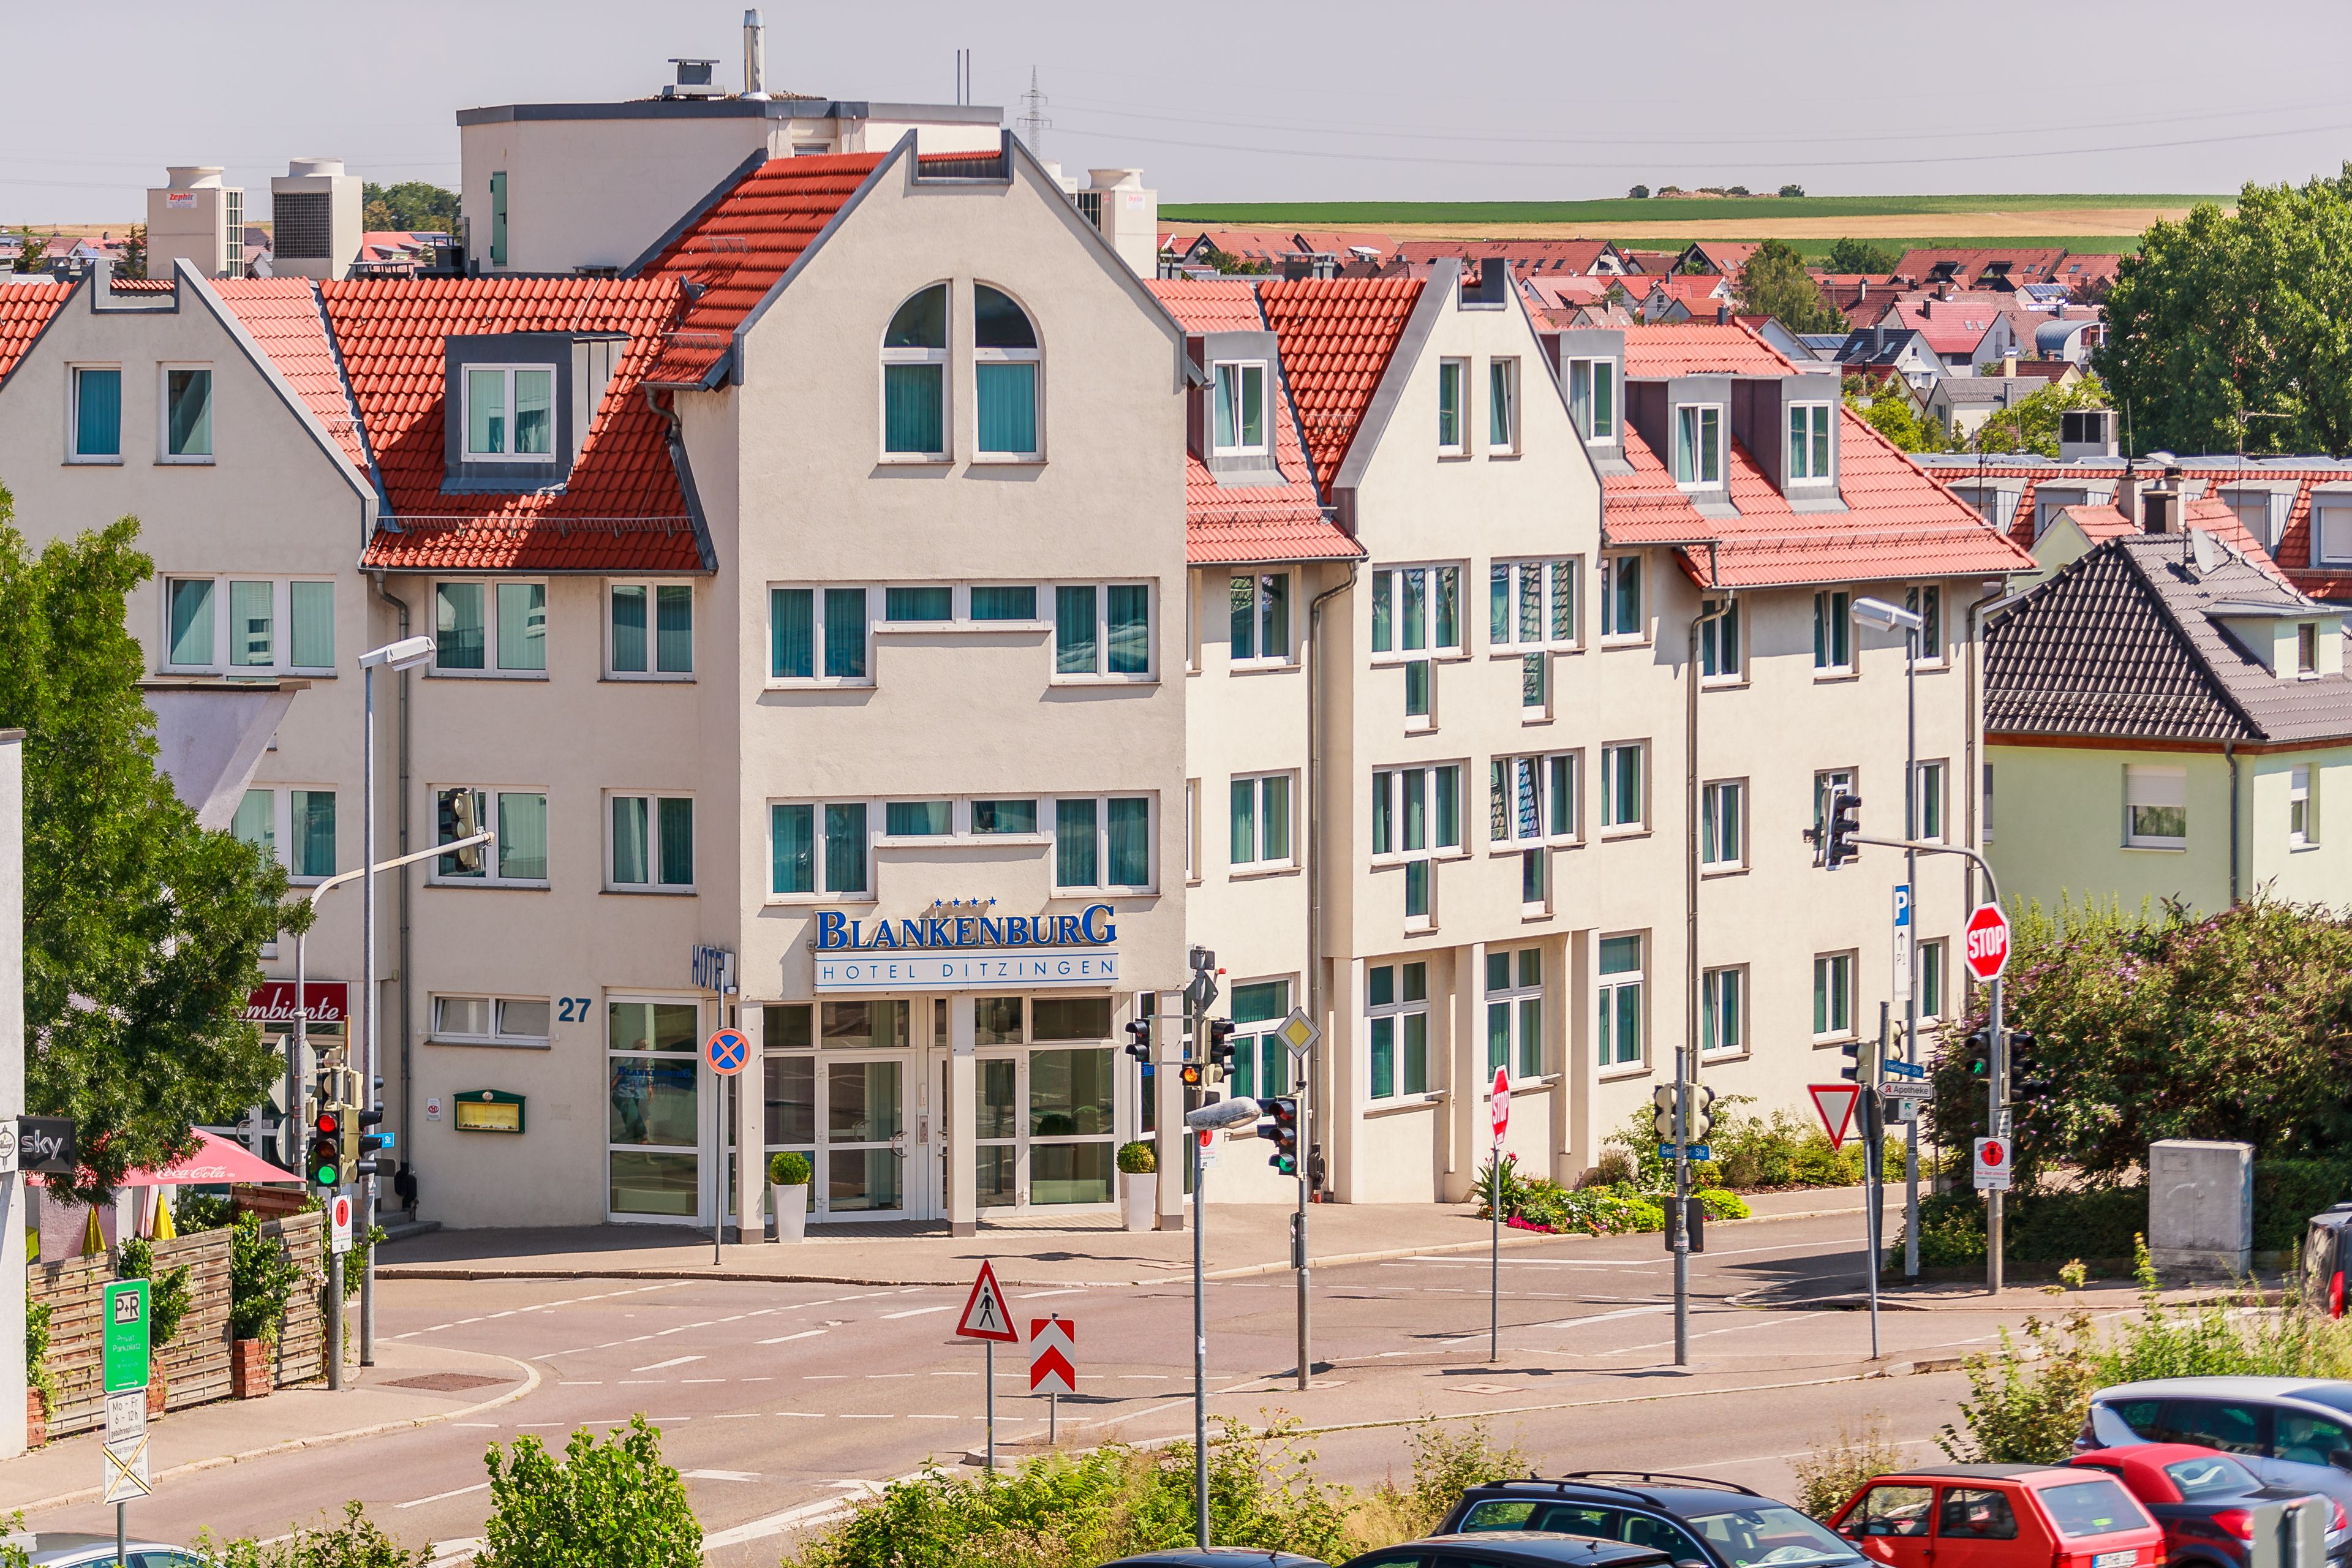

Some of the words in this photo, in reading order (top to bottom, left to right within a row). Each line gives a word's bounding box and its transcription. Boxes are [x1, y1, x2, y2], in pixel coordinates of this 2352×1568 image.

[1895, 891, 1908, 919] P
[815, 904, 1118, 949] BLANKENBURG
[1968, 924, 2005, 959] STOP
[823, 965, 916, 980] HOTEL
[942, 960, 1113, 978] DITZINGEN
[1896, 953, 1907, 966] P1
[558, 997, 592, 1022] 27
[1887, 1061, 1910, 1074] Gerlinger
[1912, 1067, 1921, 1076] Str.
[1893, 1085, 1929, 1095] Apotheke
[1493, 1090, 1509, 1125] STOP
[21, 1129, 63, 1160] sky
[1662, 1146, 1692, 1156] Gerler
[1695, 1147, 1707, 1156] Str.
[115, 1295, 140, 1319] P+R
[113, 1401, 123, 1412] Mo
[131, 1396, 138, 1408] Fr
[115, 1414, 119, 1425] 6
